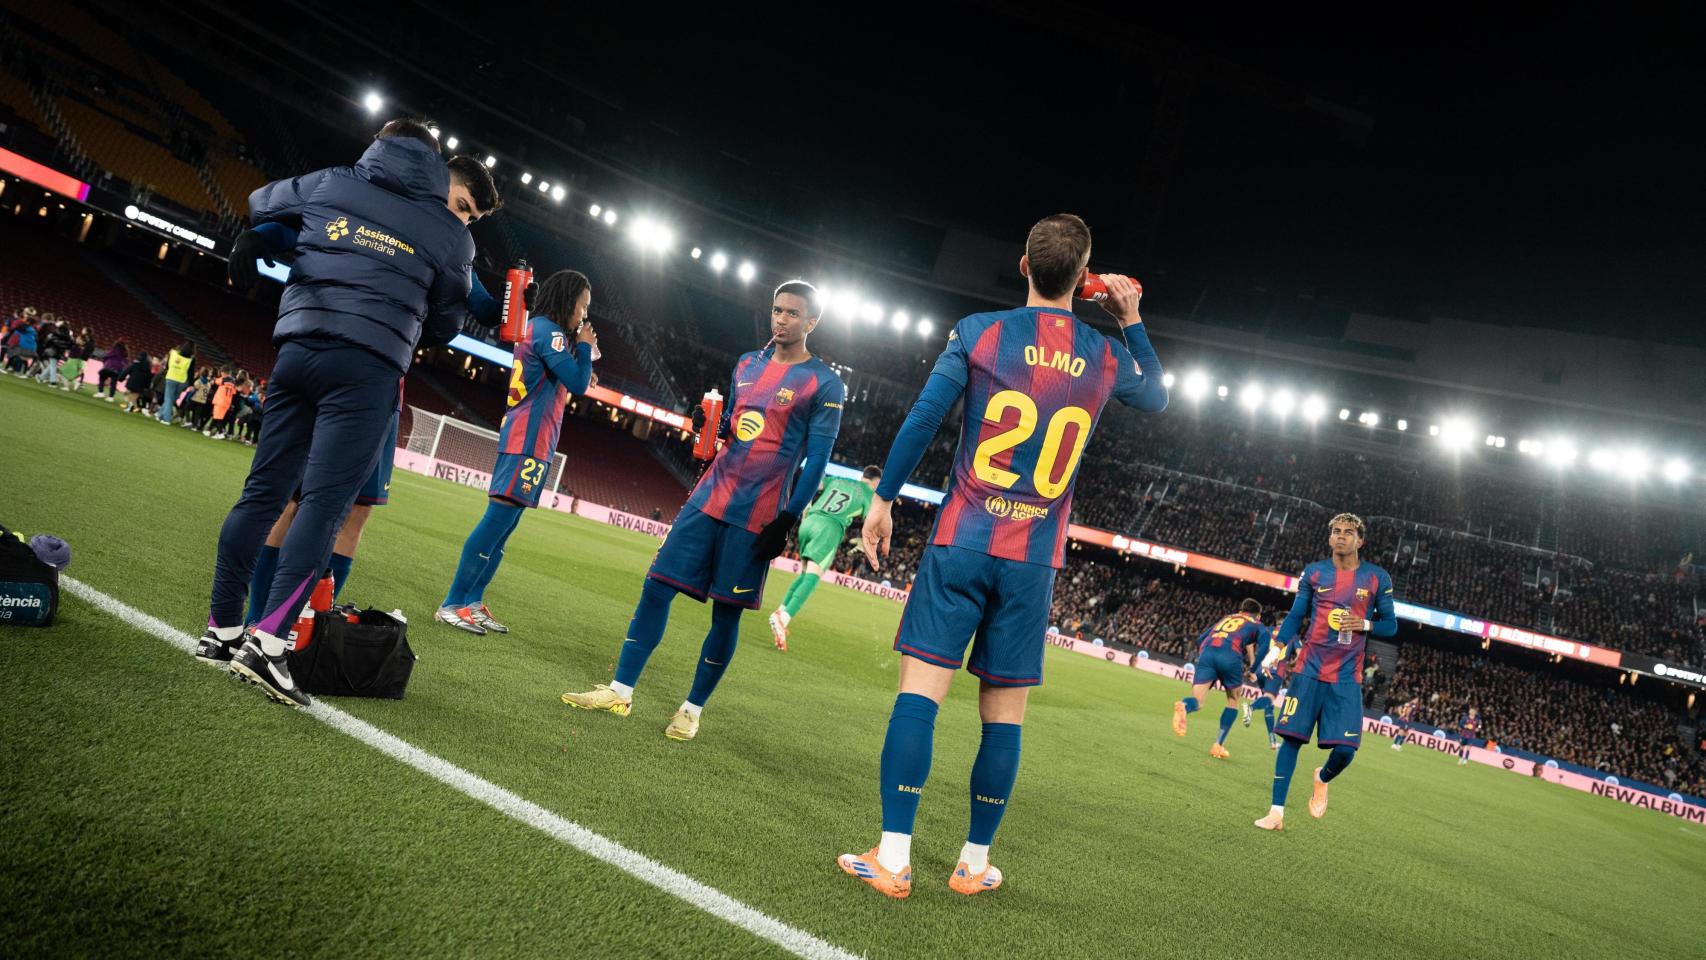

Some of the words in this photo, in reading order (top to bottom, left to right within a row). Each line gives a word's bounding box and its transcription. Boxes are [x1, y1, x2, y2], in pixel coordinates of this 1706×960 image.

[352, 234, 396, 256] Sanitària
[1024, 345, 1086, 378] OLMO
[973, 390, 1091, 499] 20
[521, 458, 544, 486] 23
[822, 489, 851, 513] 13
[608, 511, 634, 529] NEW
[633, 520, 669, 537] ALBUM
[834, 575, 865, 592] NEW
[863, 583, 907, 602] ALBUM
[1213, 616, 1246, 633] 18
[1046, 633, 1074, 650] BUM
[1175, 669, 1194, 682] NE
[1283, 696, 1299, 716] 10
[1406, 733, 1460, 756] ALBUM
[1591, 782, 1635, 802] NEW
[1636, 795, 1705, 823] ALBUM
